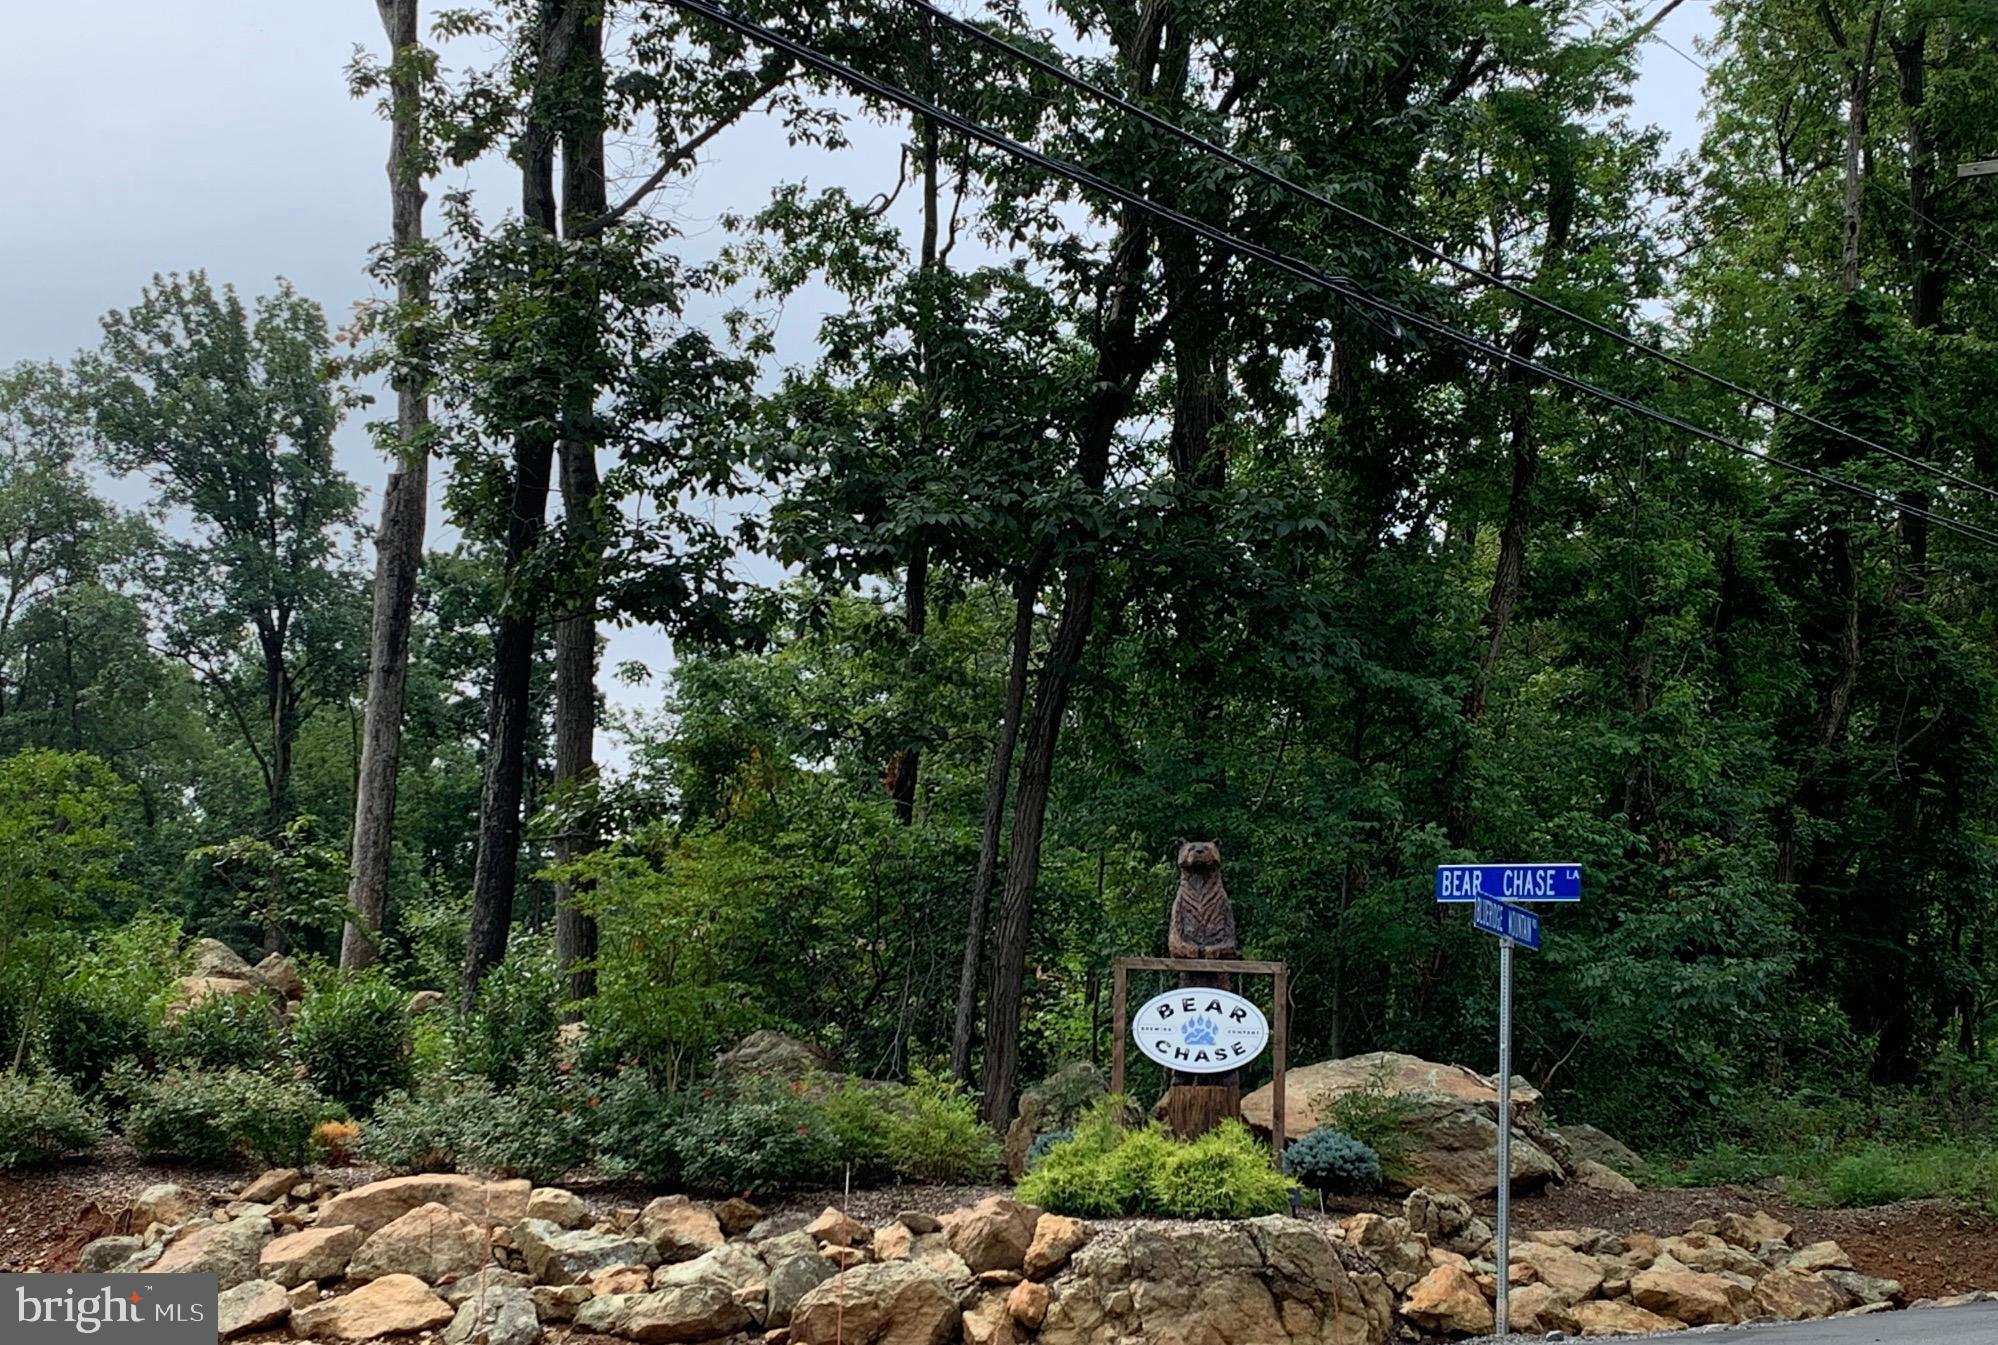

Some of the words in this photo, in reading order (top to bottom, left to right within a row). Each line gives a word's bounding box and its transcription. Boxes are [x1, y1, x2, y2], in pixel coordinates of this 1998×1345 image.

[1442, 870, 1482, 896] BEAR
[1503, 869, 1556, 896] CHASE
[1566, 869, 1580, 880] LA
[1157, 997, 1247, 1024] BEAR
[1155, 1040, 1246, 1063] CHASE
